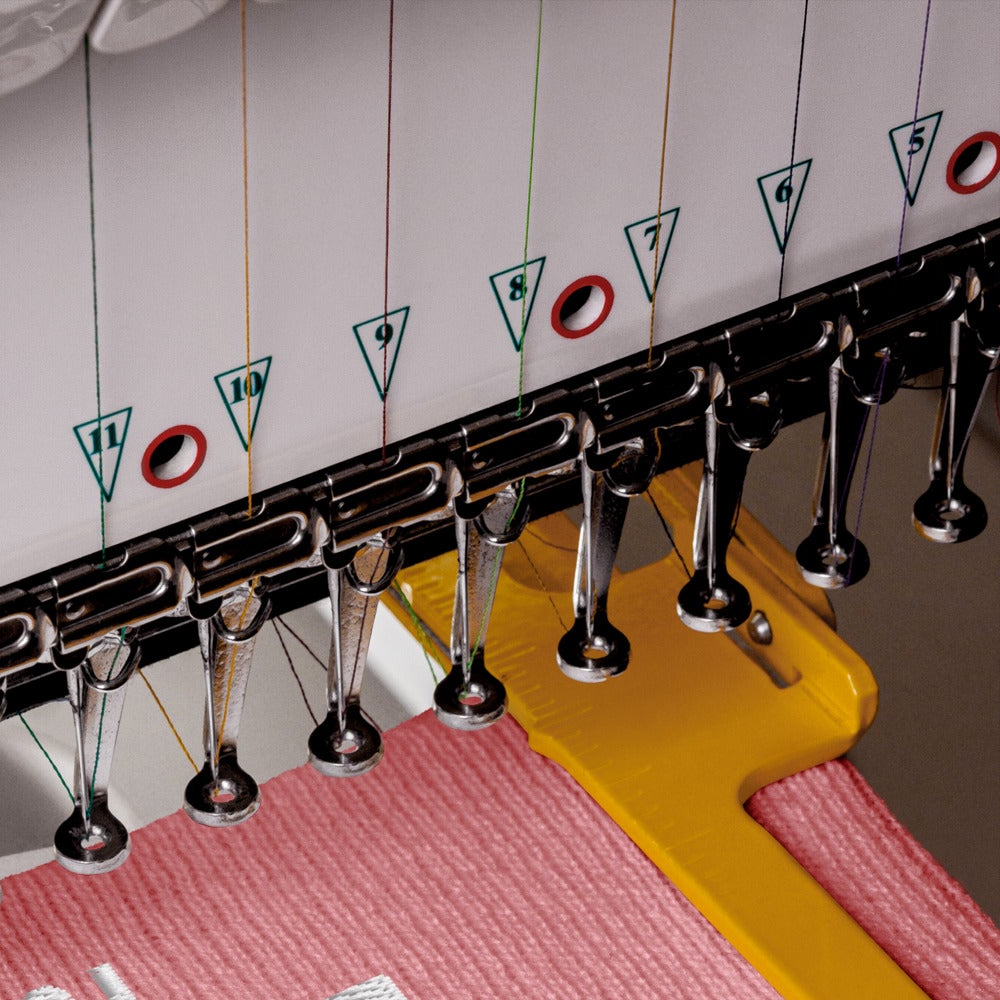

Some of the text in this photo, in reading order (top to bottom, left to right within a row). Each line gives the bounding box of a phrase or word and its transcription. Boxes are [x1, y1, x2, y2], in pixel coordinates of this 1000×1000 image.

[907, 126, 925, 155] 5
[775, 176, 793, 203] 6
[643, 224, 662, 252] 7
[509, 273, 528, 302] 8
[375, 323, 394, 351] 9
[229, 370, 263, 406] 10
[86, 421, 122, 456] 11
